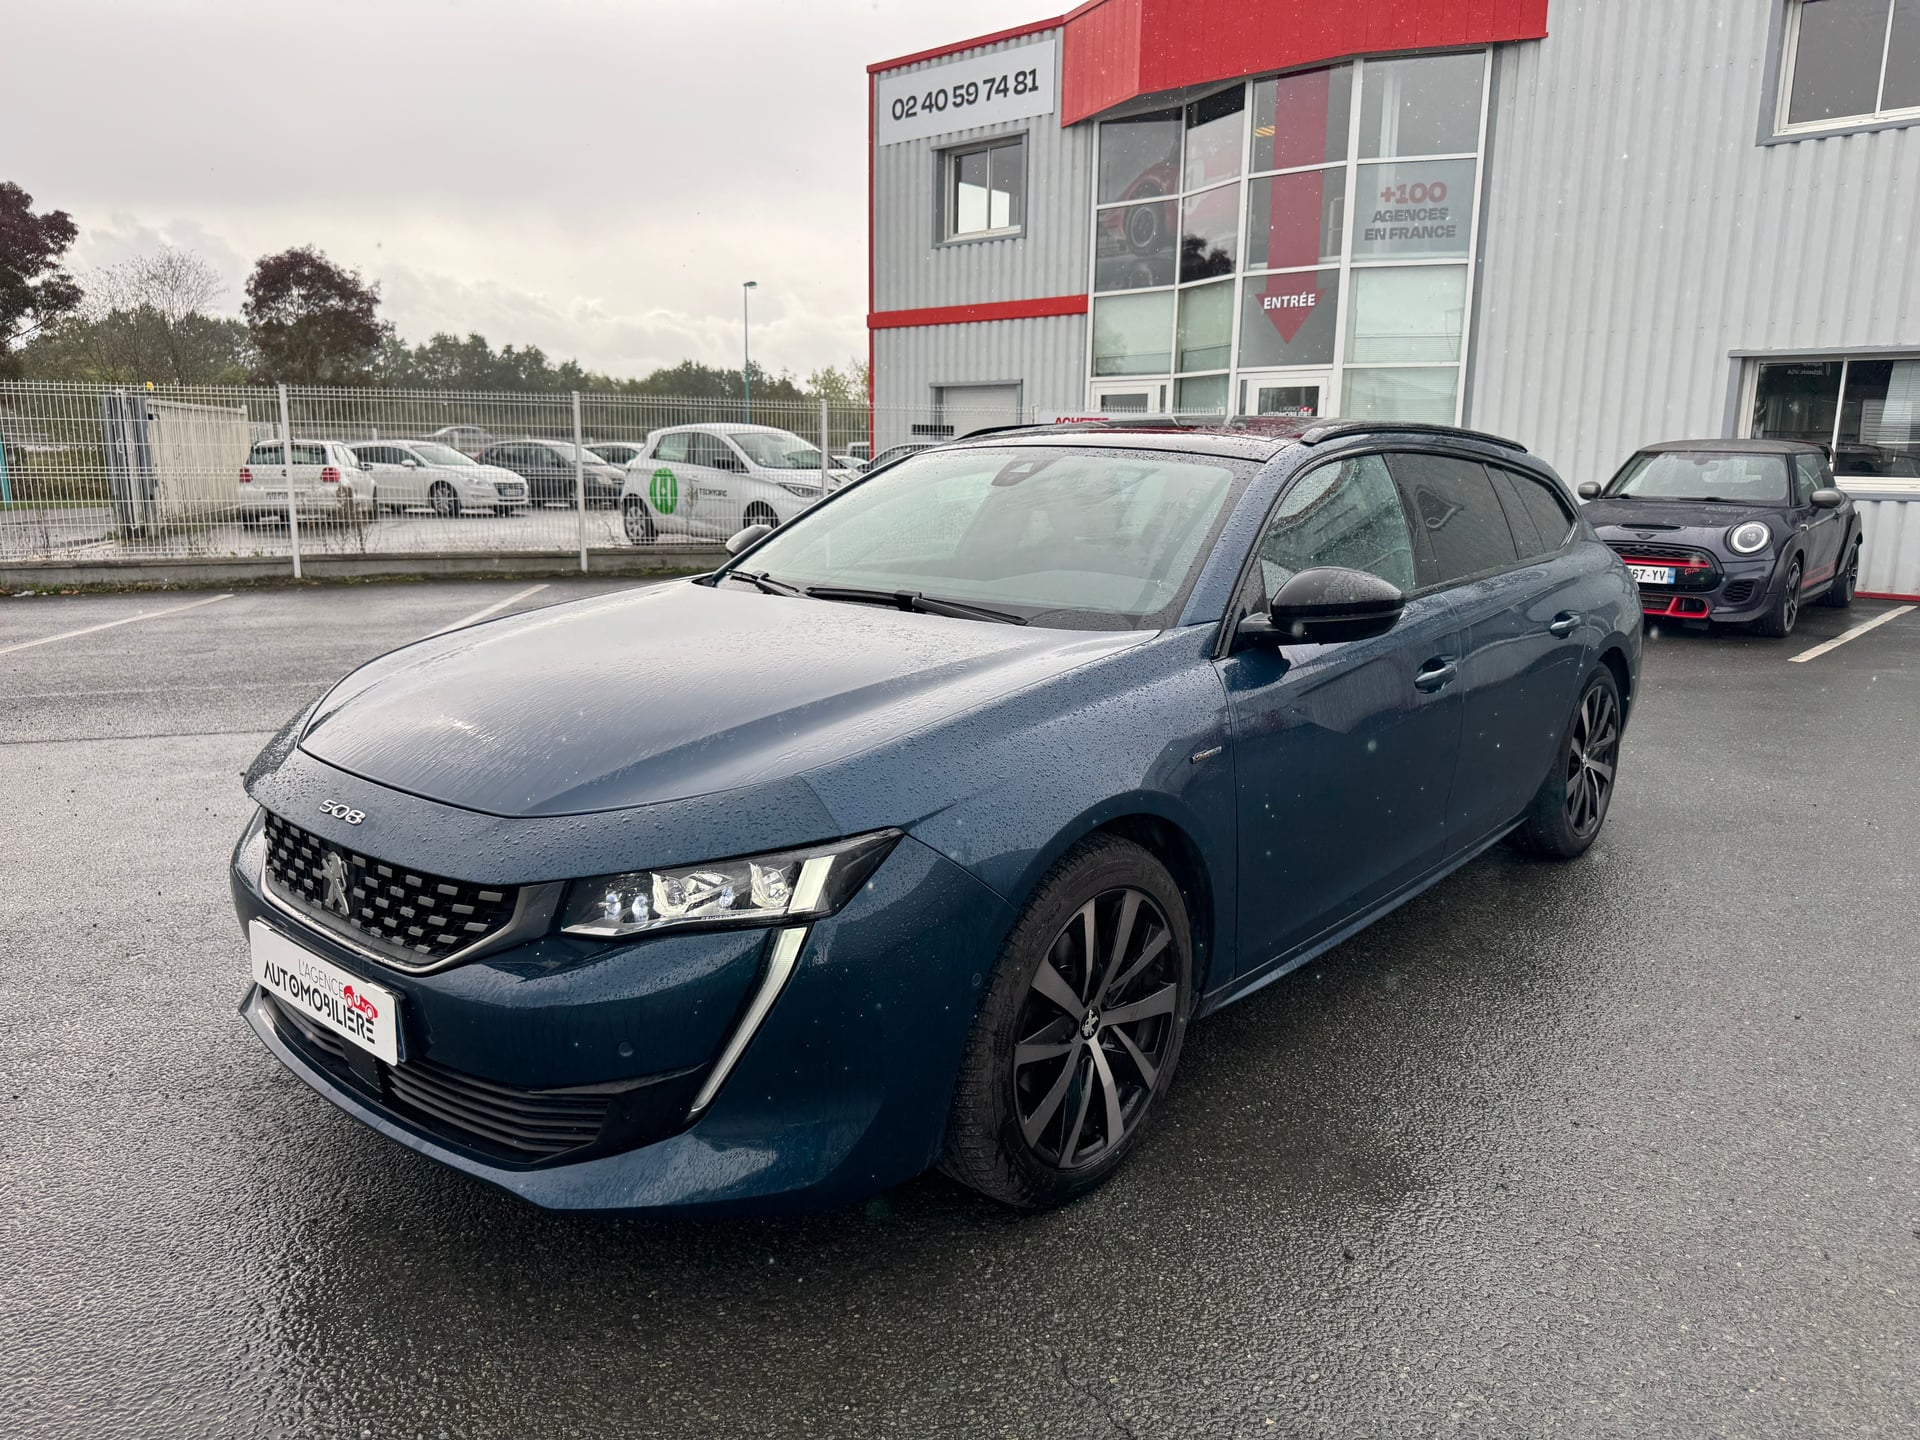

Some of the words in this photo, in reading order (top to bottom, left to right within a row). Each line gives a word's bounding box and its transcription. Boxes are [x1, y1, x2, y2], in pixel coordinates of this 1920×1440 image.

[892, 95, 917, 121] 02
[921, 88, 948, 114] 40
[952, 82, 979, 108] 59
[983, 75, 1009, 102] 74
[1013, 67, 1039, 95] 81
[1381, 182, 1447, 204] +100
[1372, 207, 1449, 223] AGENCES
[1365, 228, 1386, 241] EN
[1389, 225, 1457, 240] FRANCE
[1263, 291, 1316, 309] ENTRÉE
[319, 799, 366, 824] 508
[298, 958, 345, 1000] L'AGENCE
